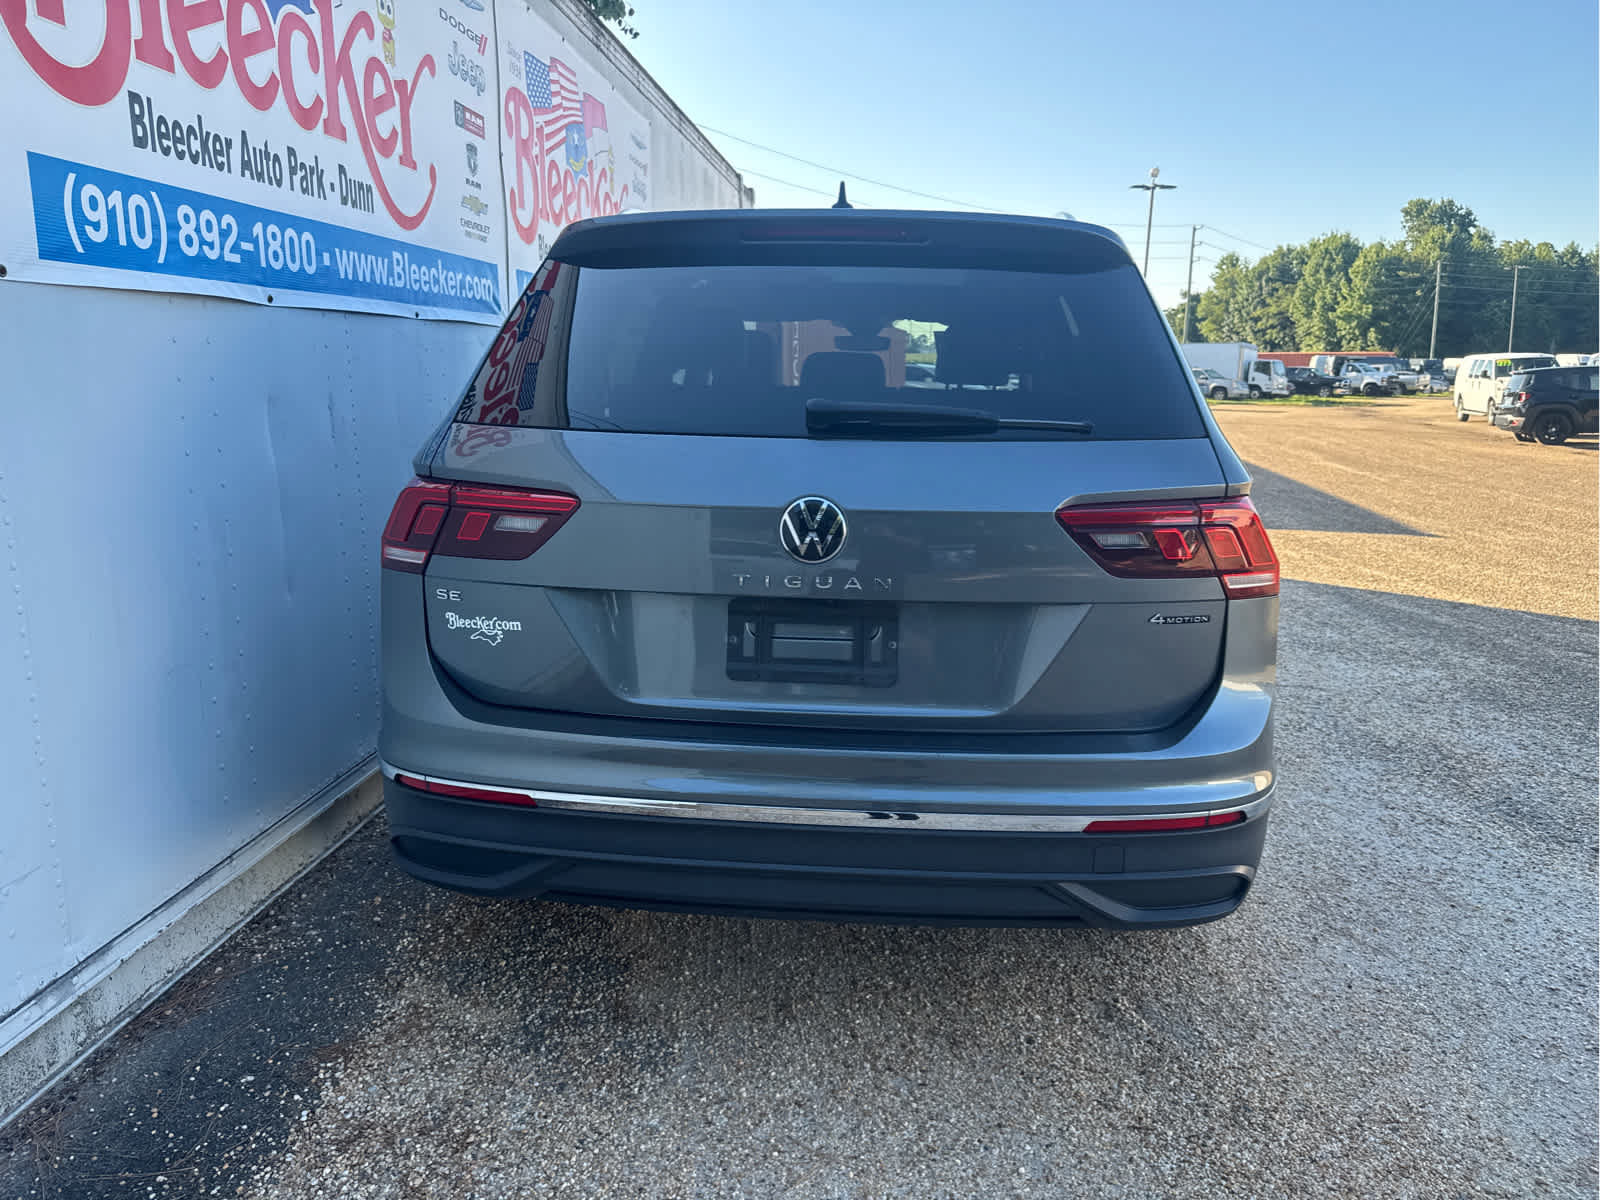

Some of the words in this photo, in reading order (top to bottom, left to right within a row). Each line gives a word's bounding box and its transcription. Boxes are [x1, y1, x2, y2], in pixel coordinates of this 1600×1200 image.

[439, 7, 482, 46] DODGE
[447, 40, 487, 97] Jeep
[128, 89, 233, 174] Bleecker
[240, 129, 283, 189] Auto
[286, 145, 327, 201] Park
[337, 163, 375, 214] Dunn
[63, 172, 168, 264] (910)
[176, 203, 317, 275] 892-1800
[335, 246, 494, 303] www.Bleecker.com
[459, 217, 491, 234] CHEVROLET
[731, 573, 893, 591] TIGUAN
[436, 588, 462, 601] SE
[444, 611, 522, 635] Bleeckercom
[1149, 612, 1209, 625] 4MOTION
